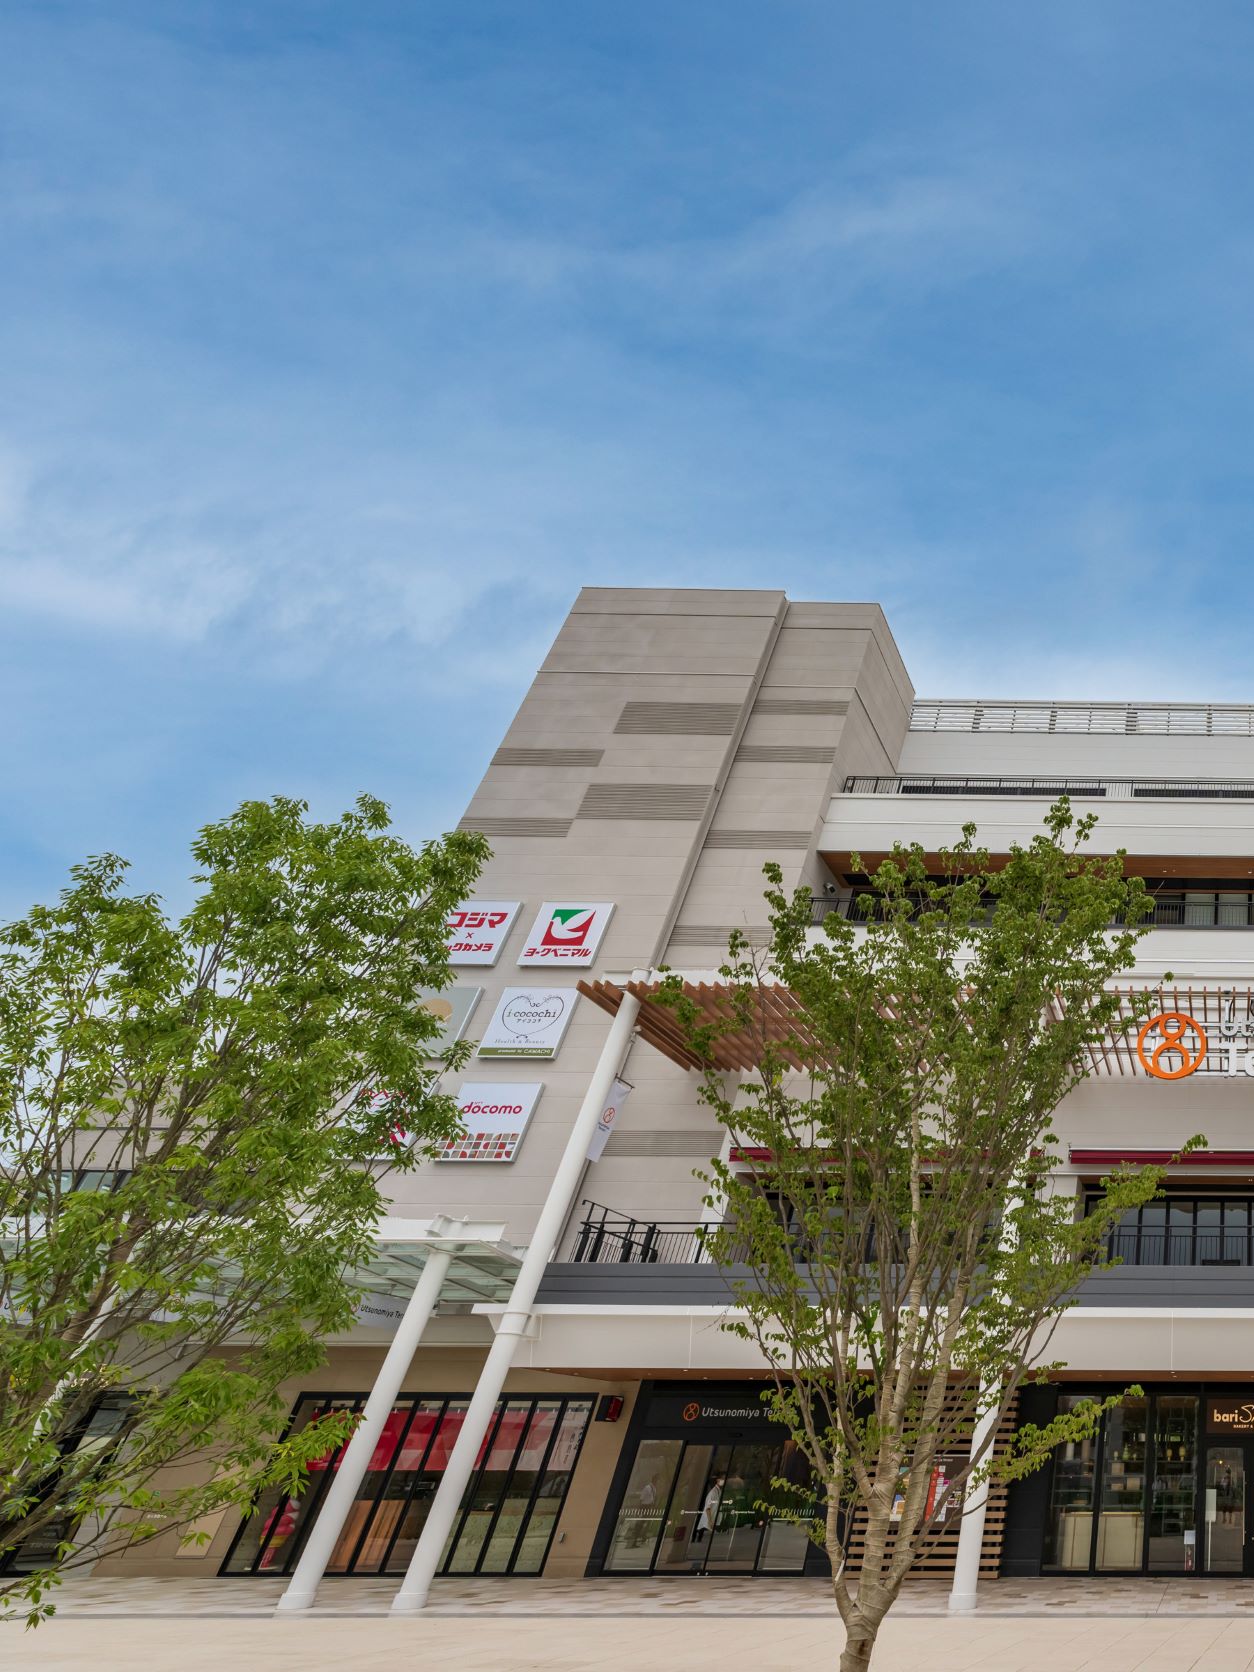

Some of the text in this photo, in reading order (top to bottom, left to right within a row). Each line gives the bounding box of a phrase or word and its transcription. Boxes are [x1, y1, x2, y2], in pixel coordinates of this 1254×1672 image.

[445, 911, 509, 929] コジマ
[447, 942, 494, 952] クカメラ
[524, 947, 592, 958] ヨークベニマル
[462, 1101, 523, 1115] docomo
[701, 1407, 760, 1419] Utsunomiya
[1213, 1409, 1239, 1422] bari
